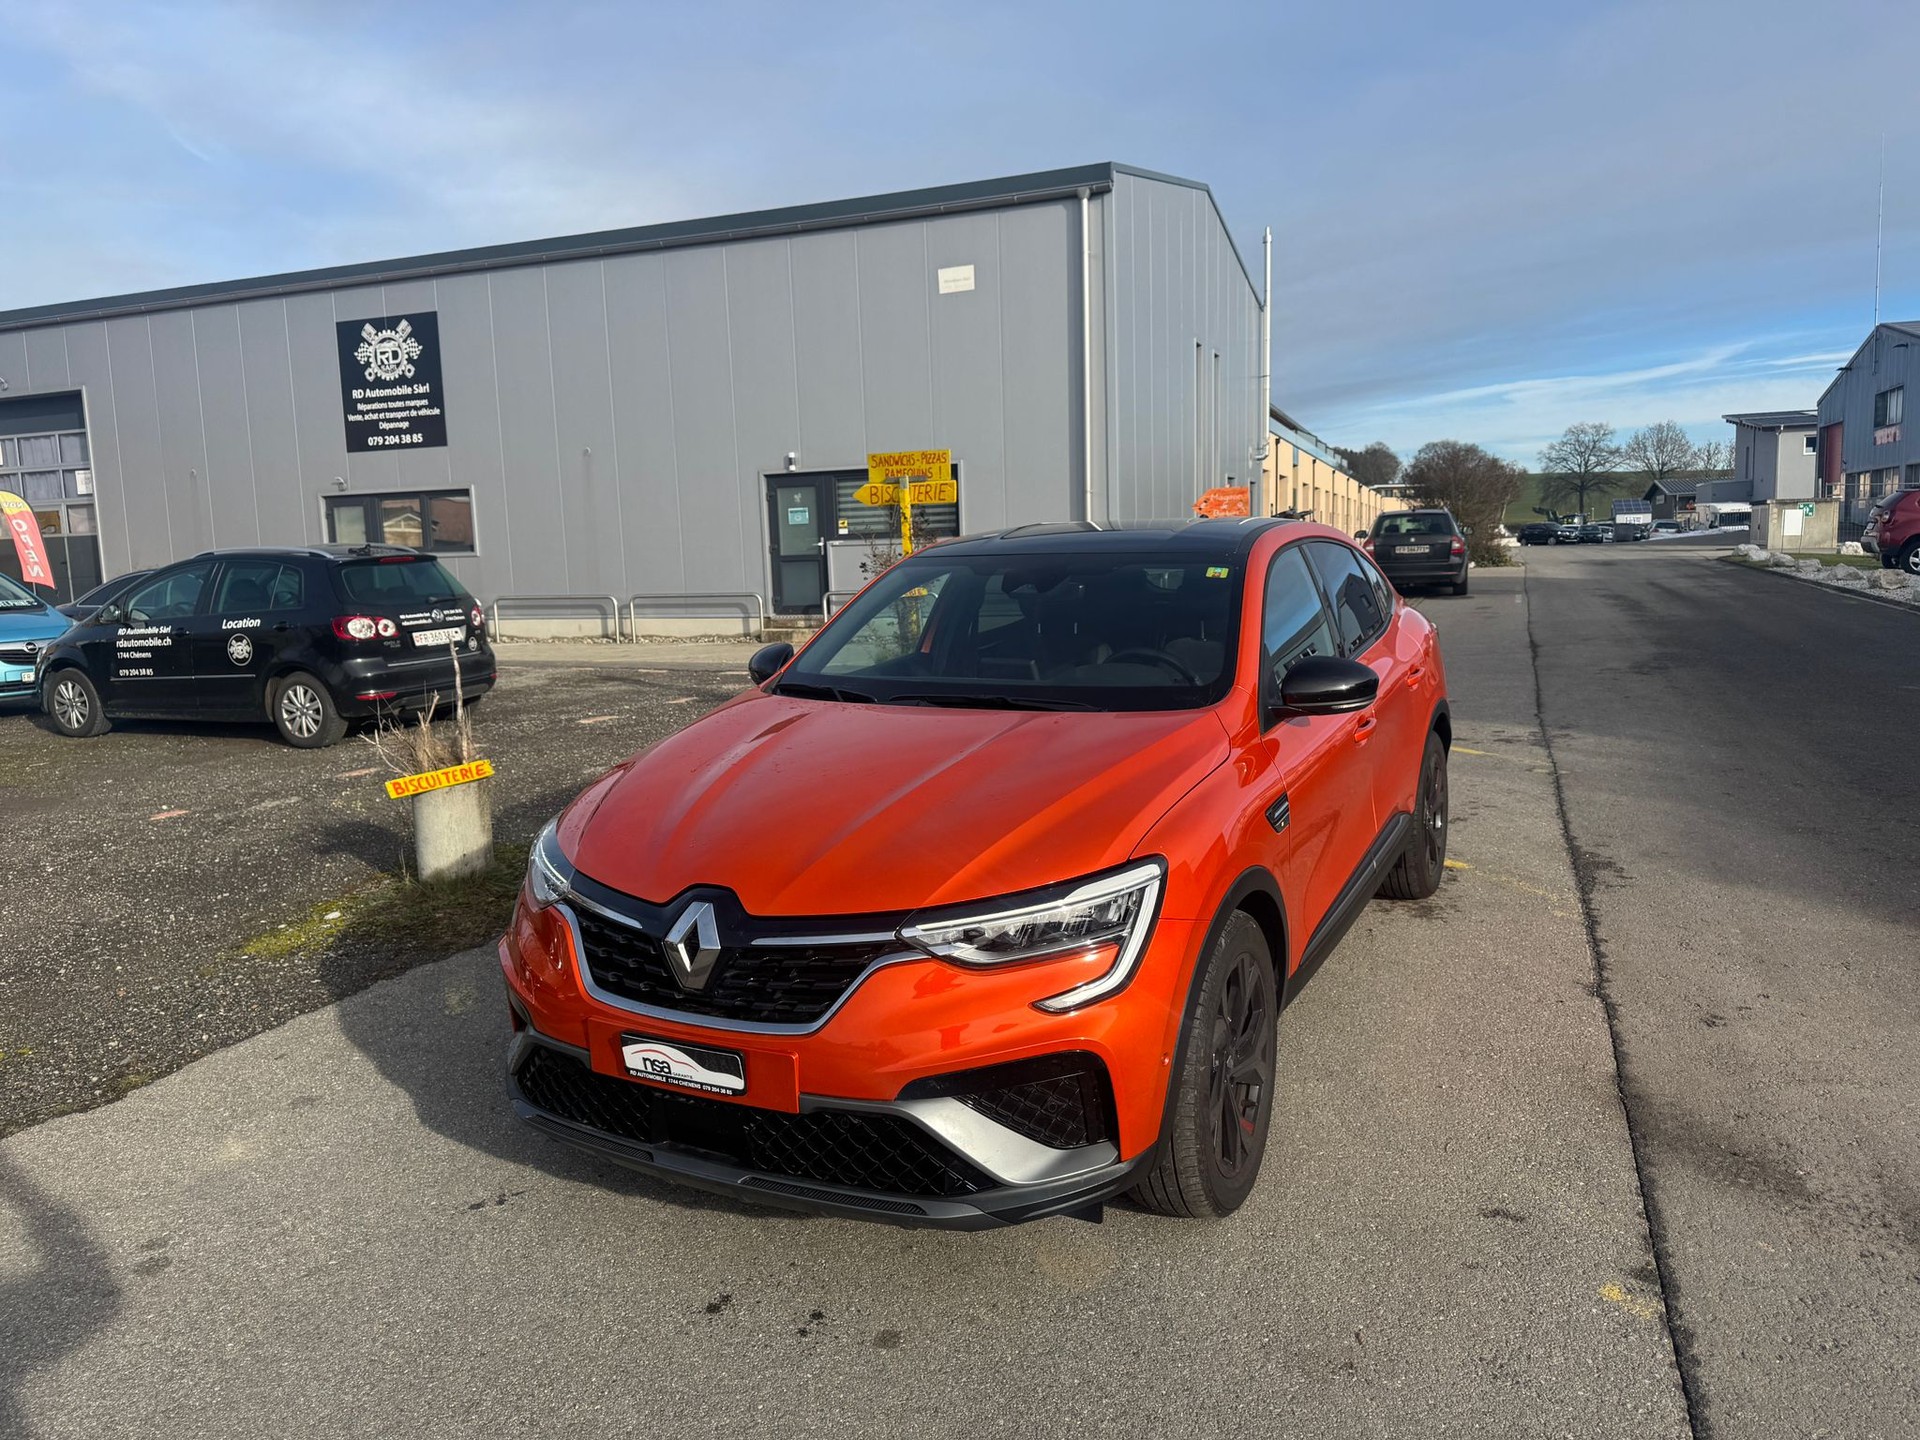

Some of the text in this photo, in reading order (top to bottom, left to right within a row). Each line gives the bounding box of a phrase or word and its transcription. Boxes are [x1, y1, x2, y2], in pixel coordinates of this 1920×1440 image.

[376, 348, 402, 366] RD
[352, 382, 430, 399] RD Automobile Sàrl
[357, 402, 388, 412] Réparations
[405, 399, 428, 408] marques
[364, 412, 379, 420] achat
[386, 410, 410, 419] transport
[418, 407, 440, 415] véhicule
[379, 421, 410, 430] Dépannage
[368, 433, 424, 446] 079 204 38 85
[870, 483, 948, 505] BISCTERIE
[126, 626, 159, 635] Automobile
[222, 618, 261, 630] Location
[116, 636, 172, 648] rdautomobile.ch
[419, 633, 429, 643] FR
[392, 763, 486, 796] BISCUITERIE
[642, 1057, 672, 1075] nsa
[637, 1072, 666, 1082] AUTOMOBILE
